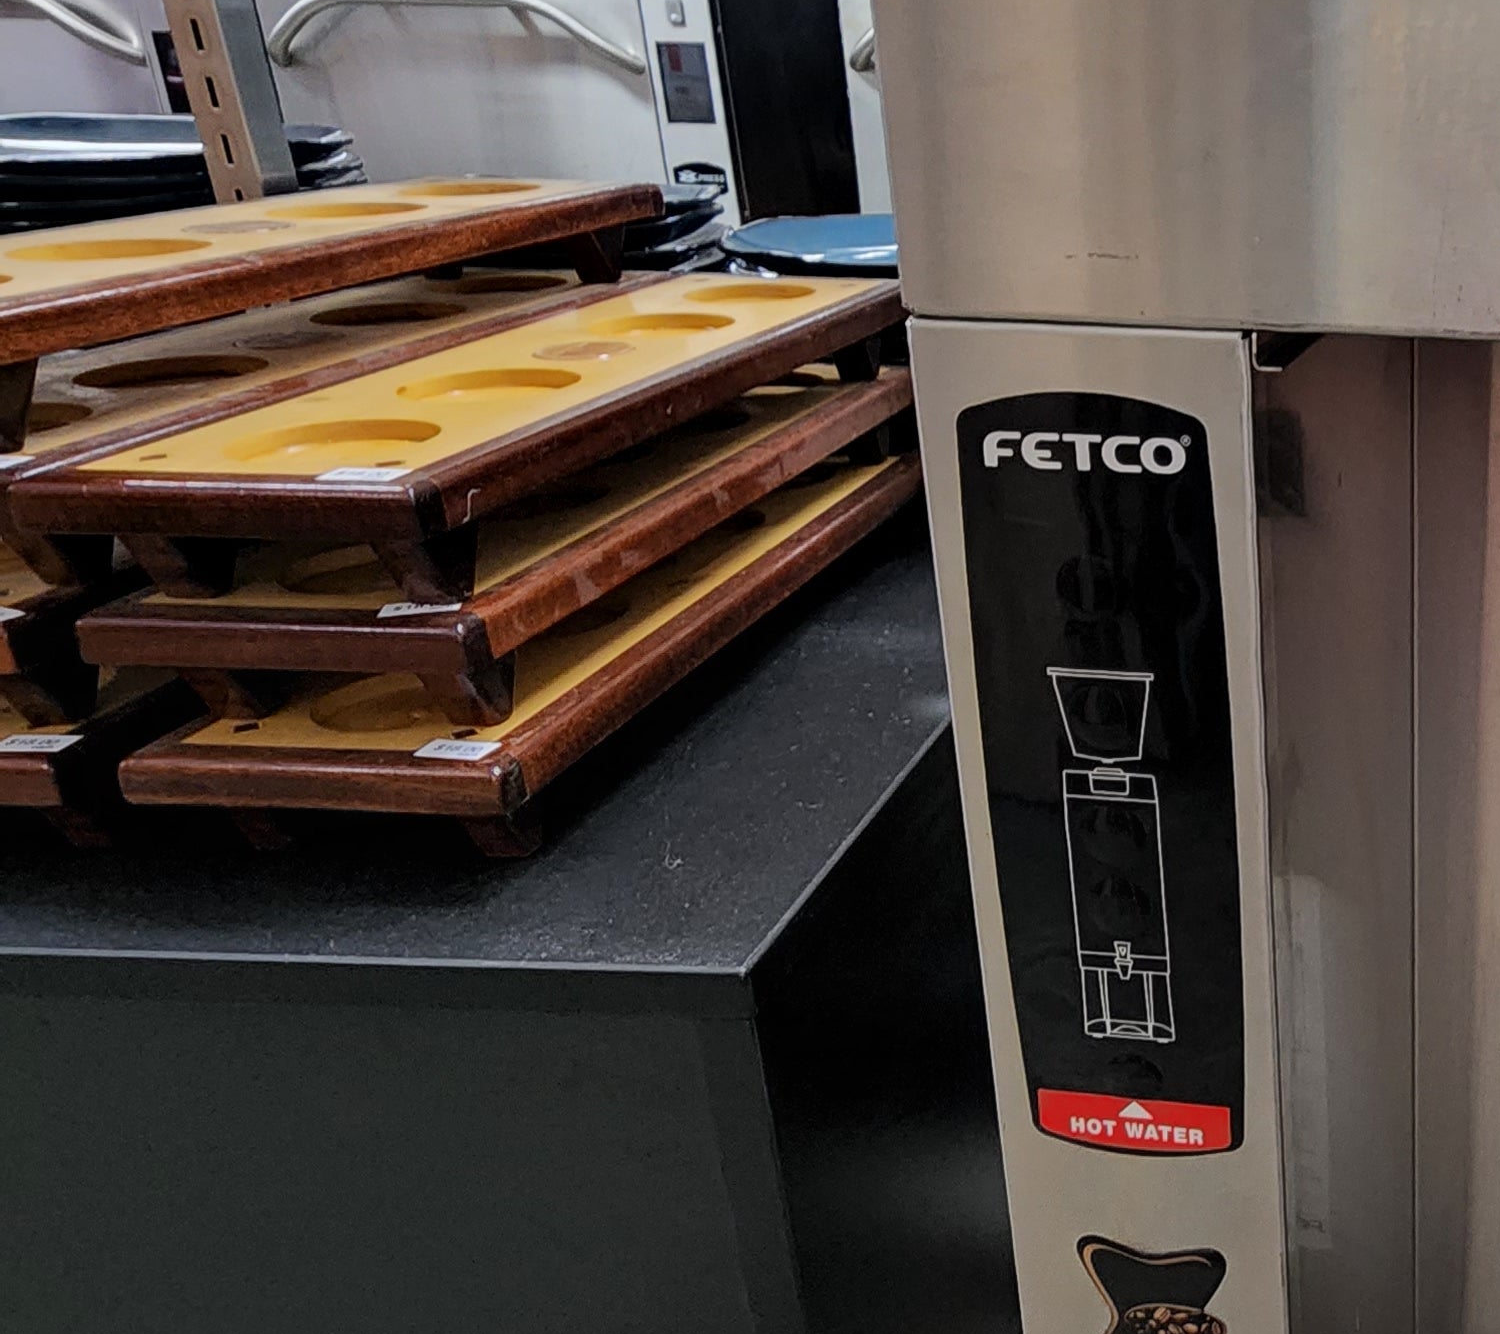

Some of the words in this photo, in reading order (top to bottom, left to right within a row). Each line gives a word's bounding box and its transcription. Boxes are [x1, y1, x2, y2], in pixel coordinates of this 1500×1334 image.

[983, 430, 1187, 475] FETCO
[1070, 1116, 1117, 1137] HOT
[1124, 1121, 1204, 1145] WATER
